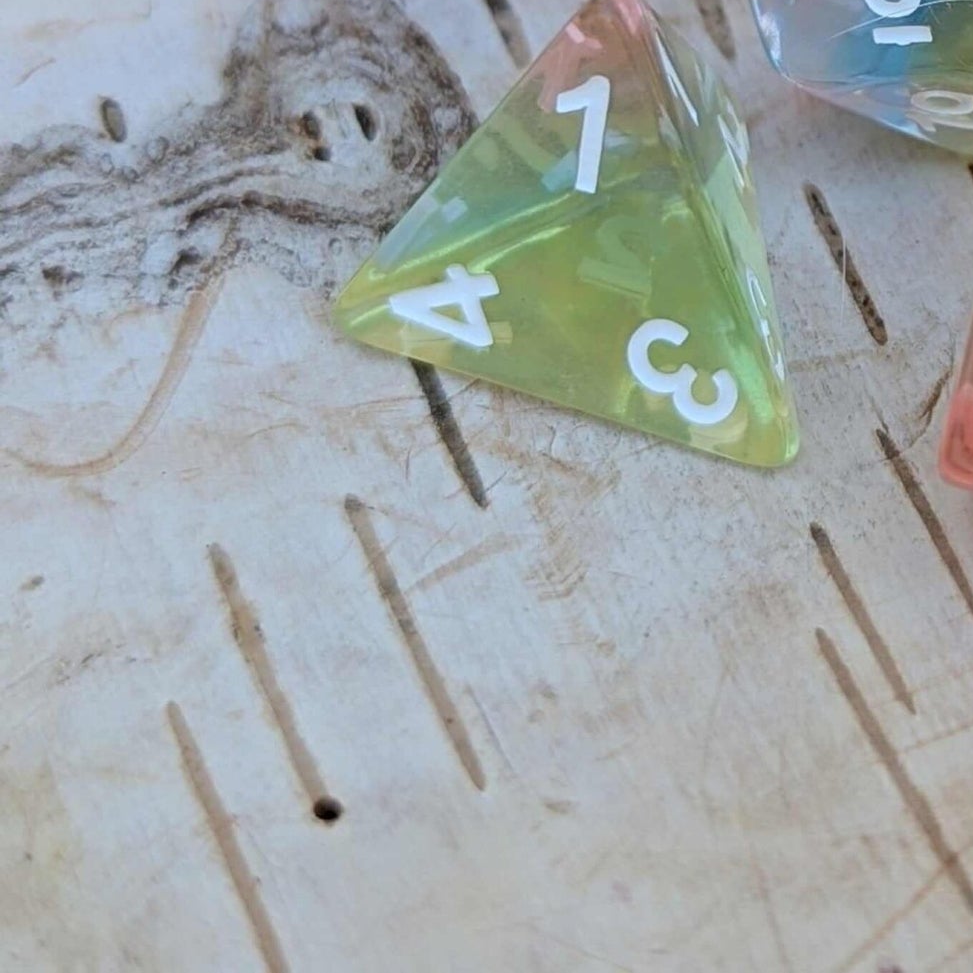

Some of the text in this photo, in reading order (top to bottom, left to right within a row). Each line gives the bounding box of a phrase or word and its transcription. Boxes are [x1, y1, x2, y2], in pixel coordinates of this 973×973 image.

[556, 75, 610, 194] 1
[388, 263, 500, 347] 4
[626, 317, 739, 425] 3
